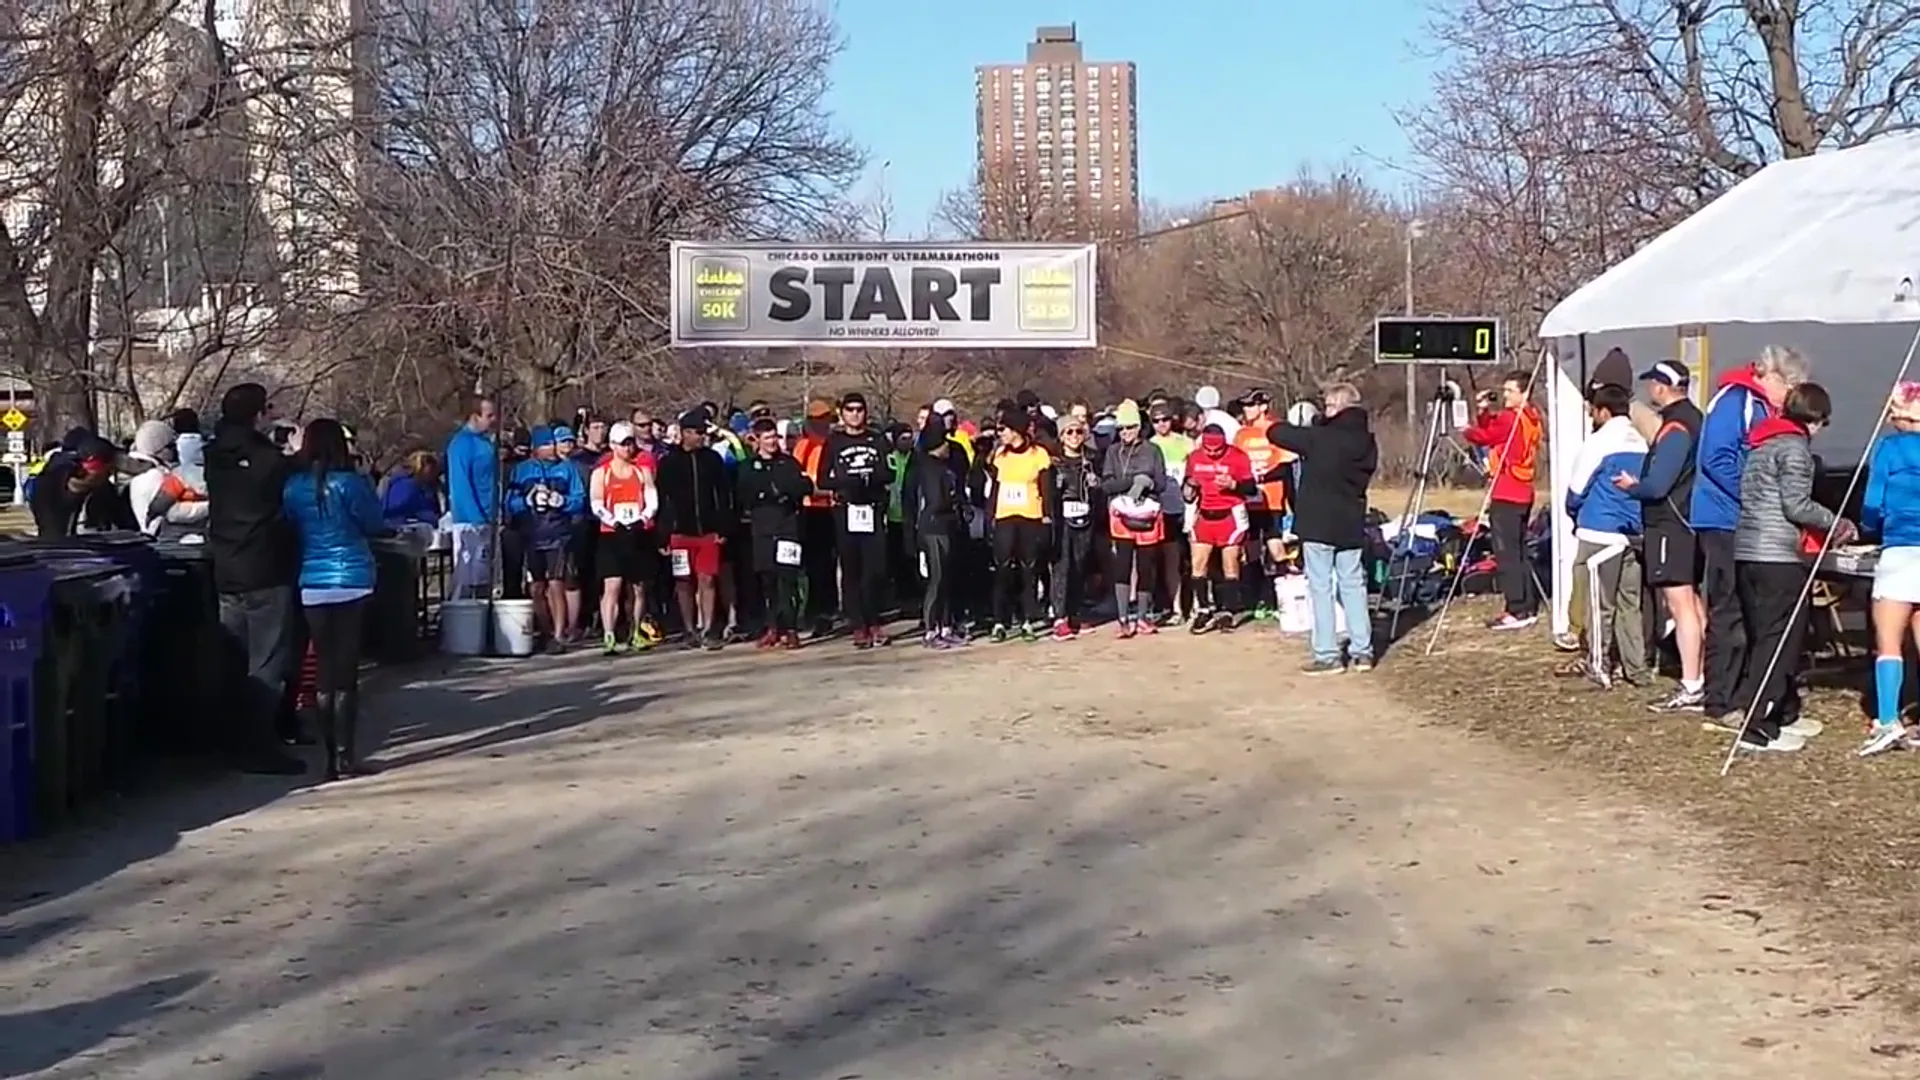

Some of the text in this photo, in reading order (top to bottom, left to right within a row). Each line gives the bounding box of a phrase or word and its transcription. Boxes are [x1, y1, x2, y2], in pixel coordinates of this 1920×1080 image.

[822, 253, 889, 262] LAKEFRONT
[892, 252, 1001, 262] ULTRAMARATHONS
[767, 266, 1001, 321] START
[702, 301, 736, 318] 50K
[828, 327, 845, 336] NO
